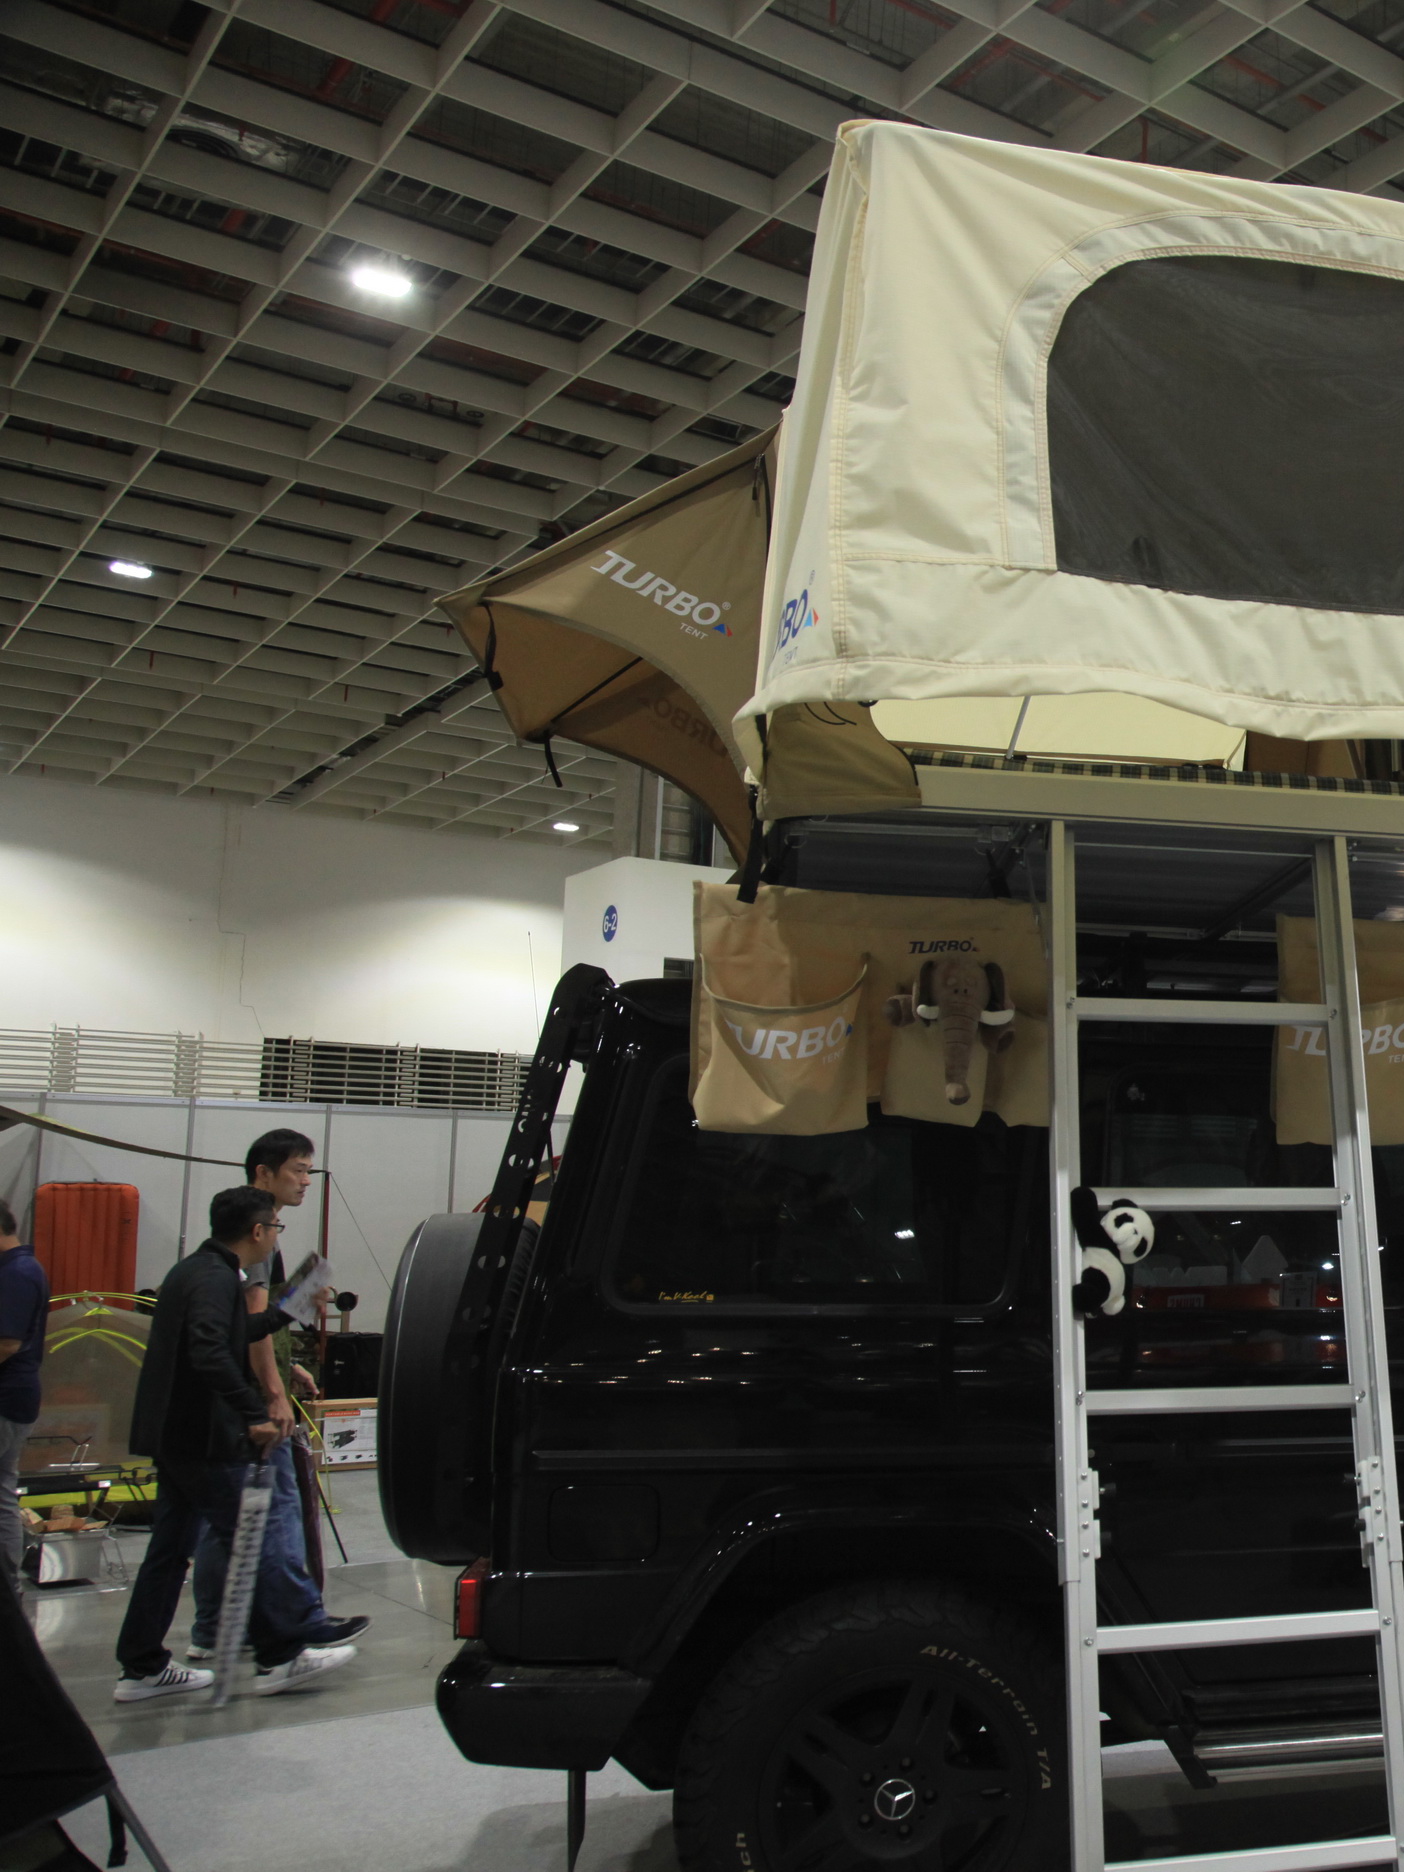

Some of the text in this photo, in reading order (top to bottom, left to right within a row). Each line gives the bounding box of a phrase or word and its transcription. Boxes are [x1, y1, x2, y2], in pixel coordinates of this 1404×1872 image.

[590, 550, 721, 626] TURBO
[680, 622, 709, 640] TENT
[603, 913, 618, 933] 6-2
[908, 940, 972, 954] TURBO
[920, 1645, 1052, 1790] All-Terrain T/A
